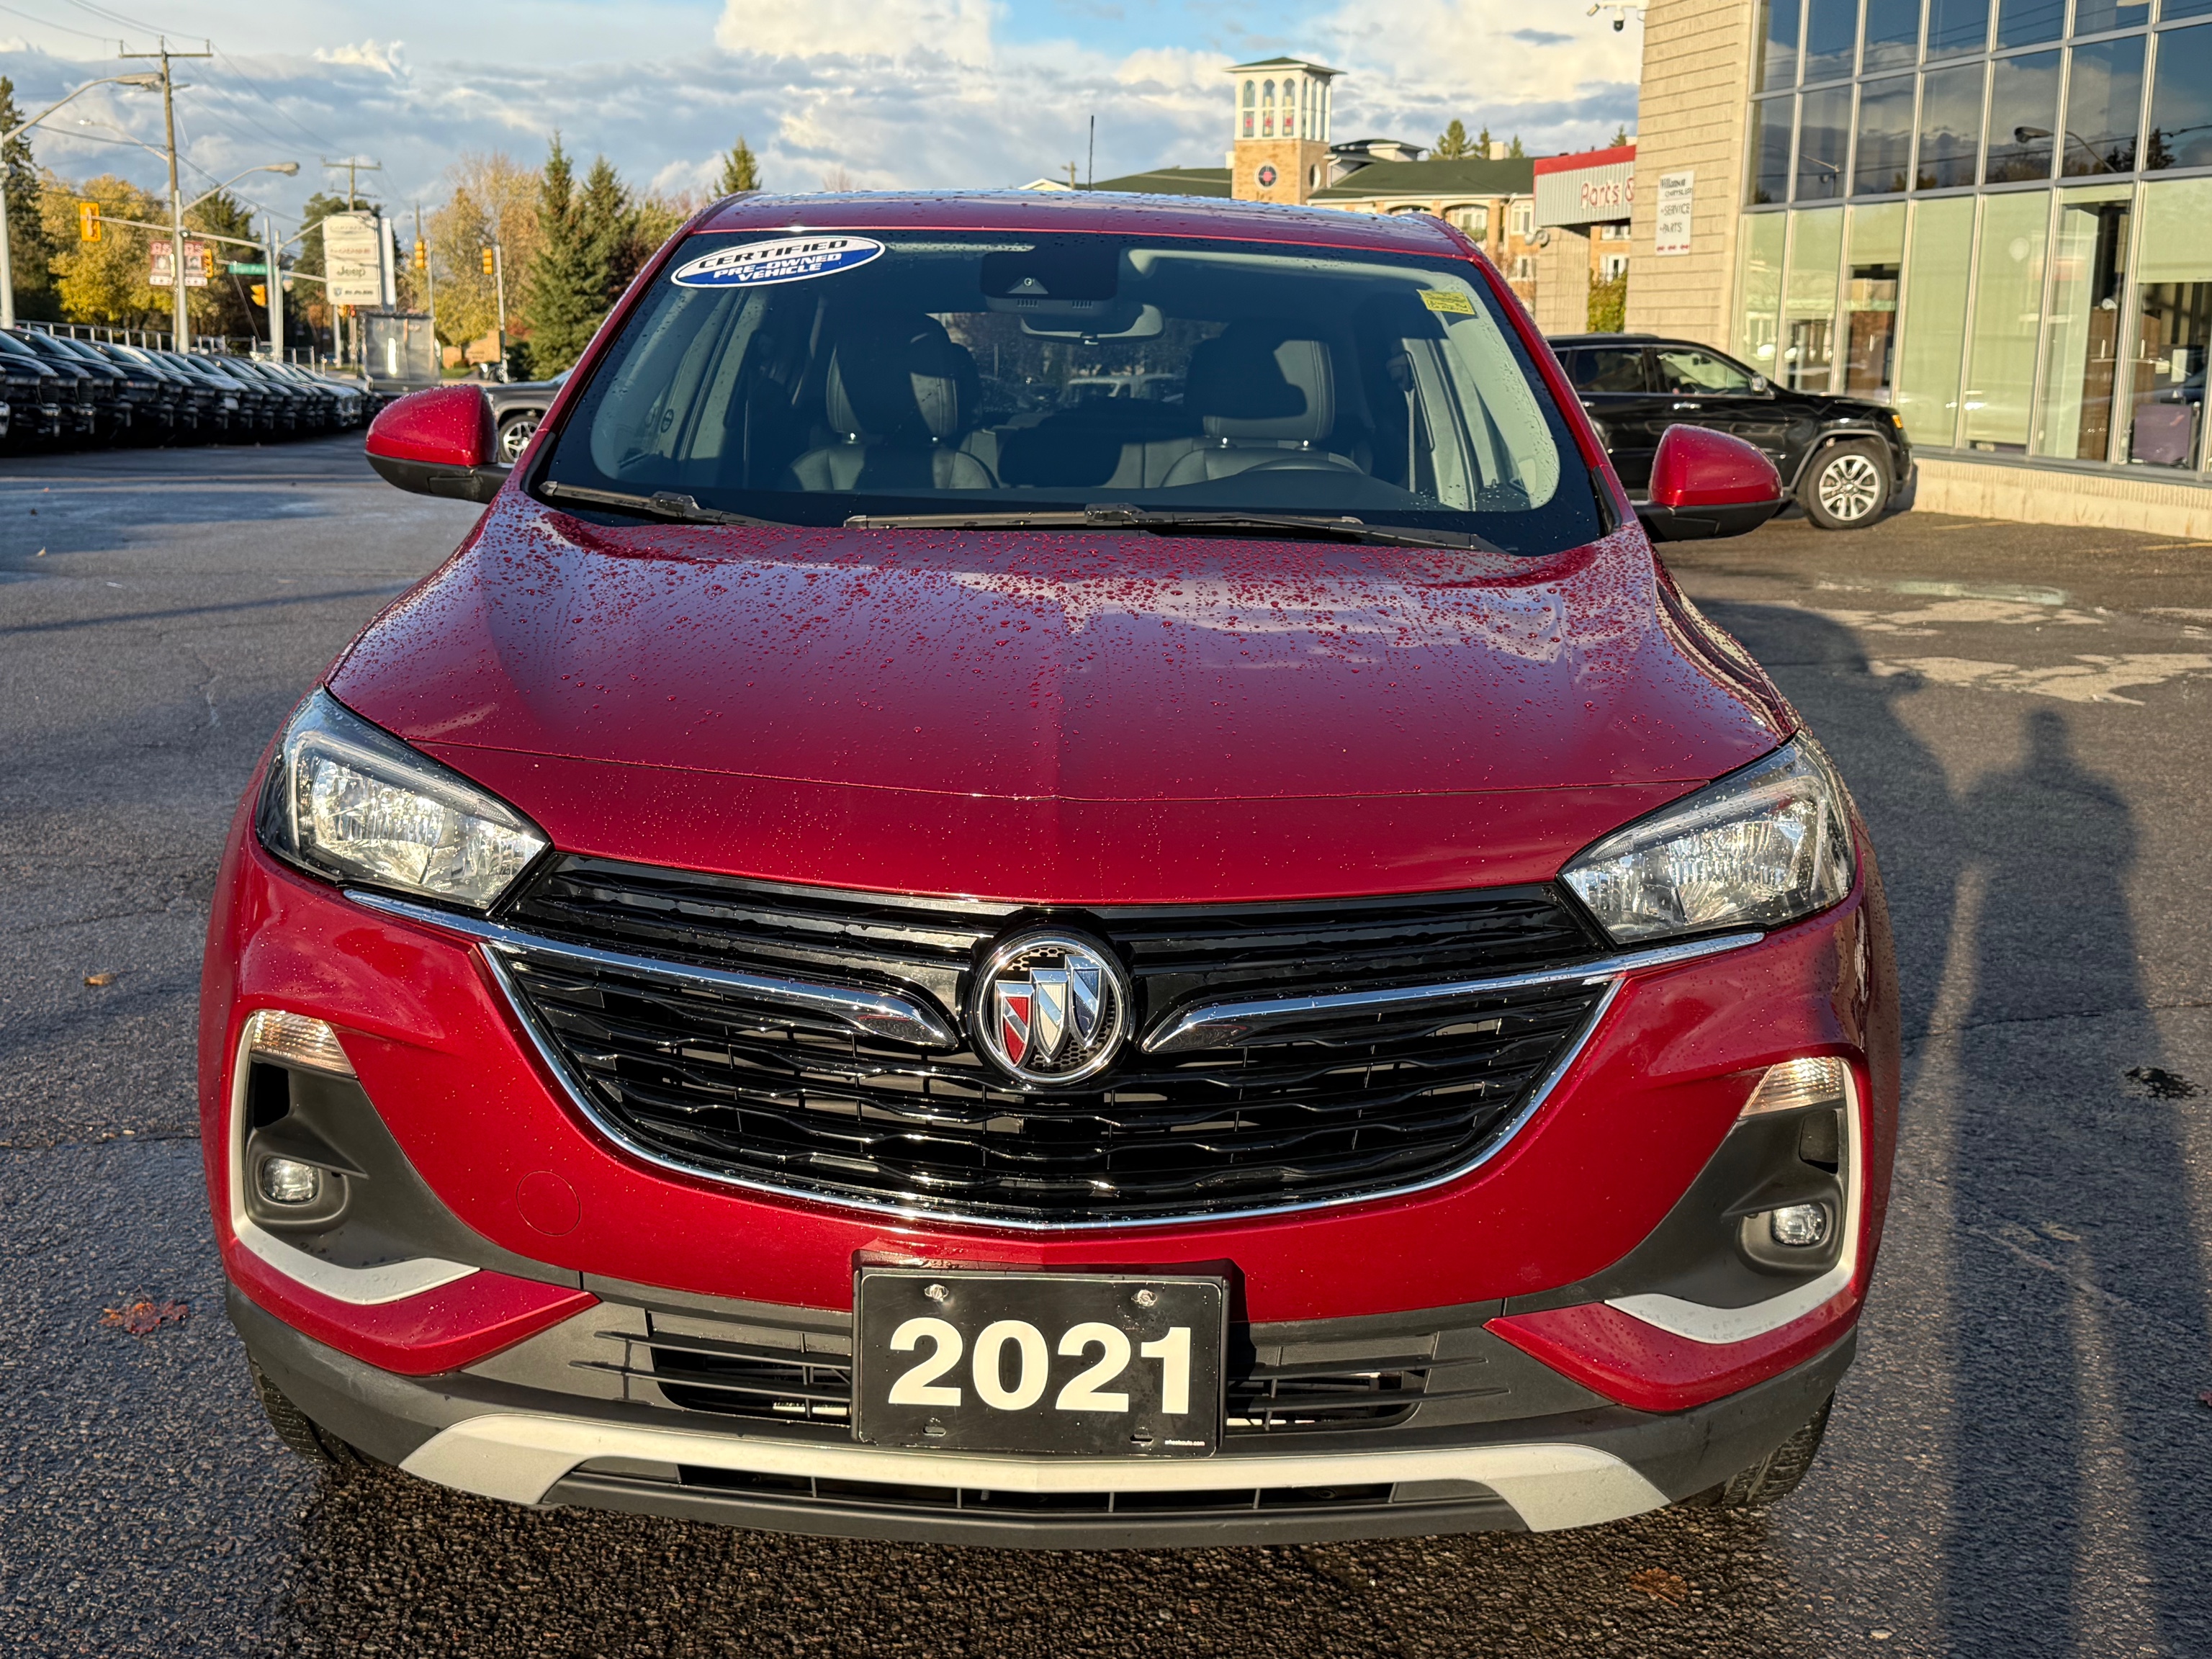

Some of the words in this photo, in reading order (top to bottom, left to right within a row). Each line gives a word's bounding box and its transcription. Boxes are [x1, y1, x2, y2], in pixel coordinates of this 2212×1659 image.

[1581, 181, 1621, 210] Parts
[1664, 203, 1690, 215] SERVICE
[1662, 222, 1682, 233] PARTS
[698, 240, 848, 269] CERTIFIED
[713, 253, 842, 279] PRE-OWNED
[336, 266, 367, 279] Jeep
[738, 262, 822, 282] VEHICLE
[888, 1317, 1191, 1415] 2021
